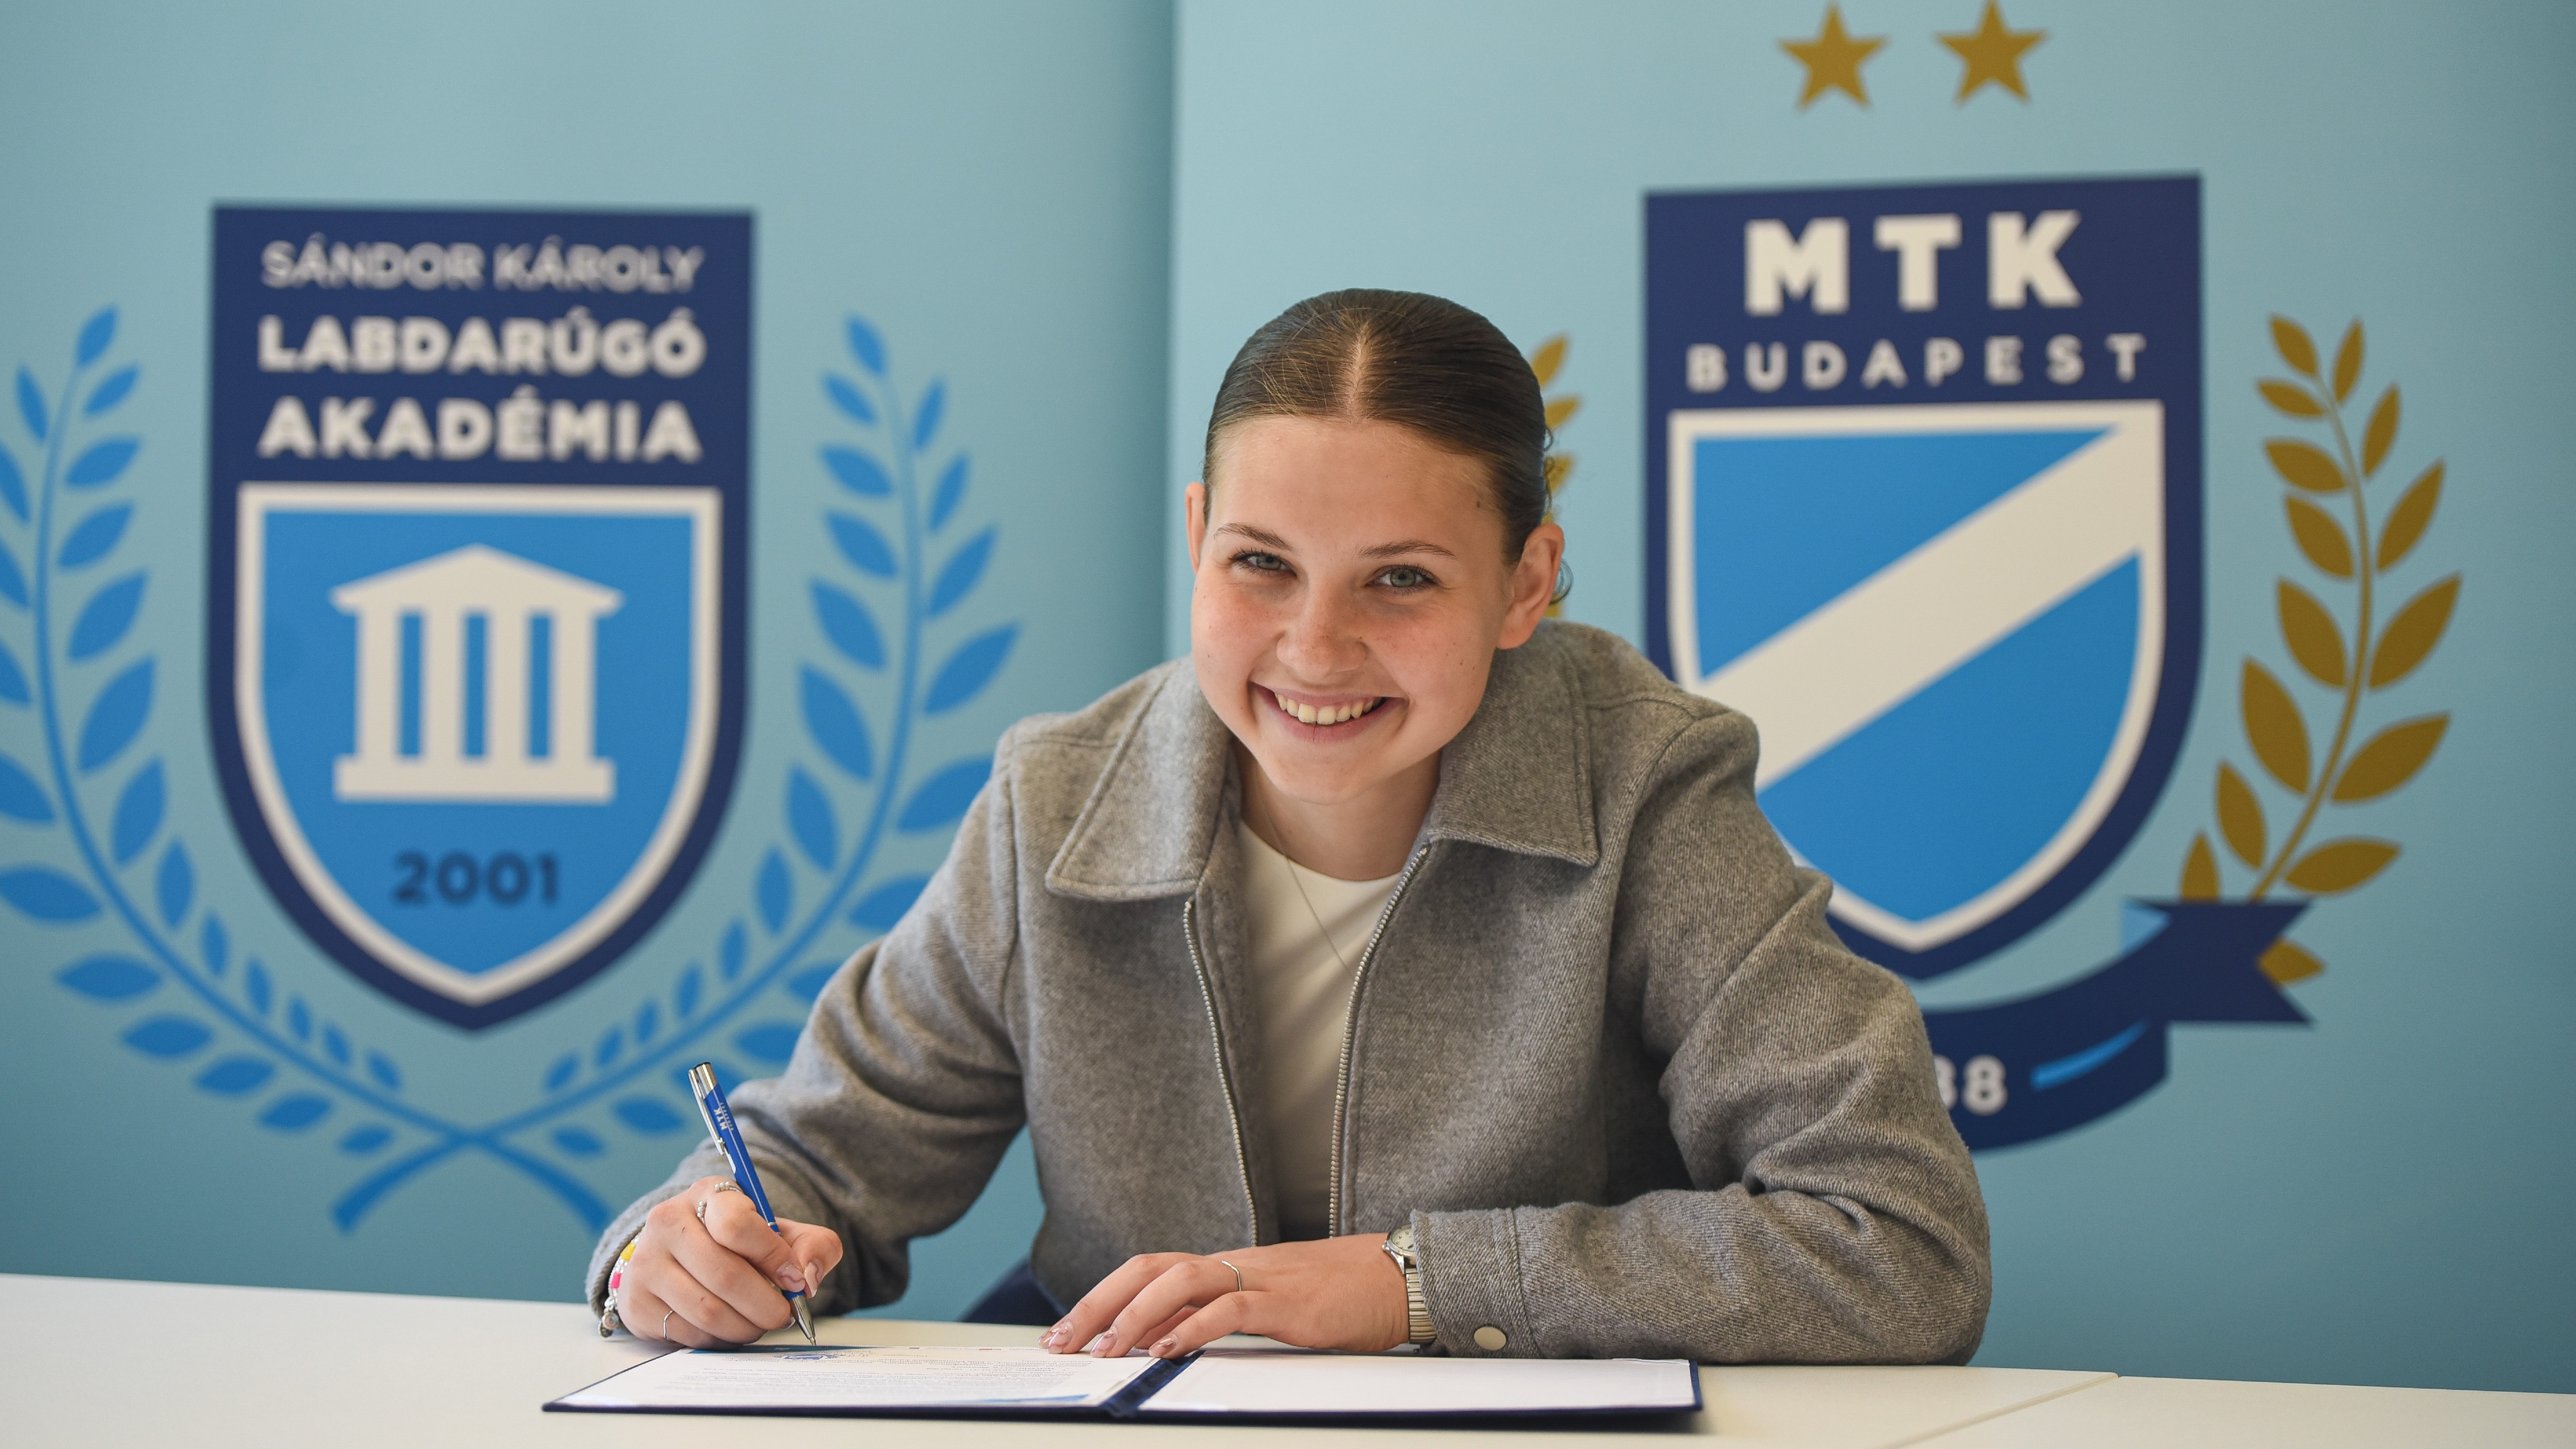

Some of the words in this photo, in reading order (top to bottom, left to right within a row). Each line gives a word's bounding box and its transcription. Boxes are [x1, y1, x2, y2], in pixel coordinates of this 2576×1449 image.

[261, 232, 484, 291] SÁNDOR
[494, 234, 704, 294] KÁROLY
[1745, 209, 2082, 316] MTK
[258, 305, 708, 377] LABDARÚGÓ
[1685, 333, 2146, 394] BUDAPEST
[257, 384, 703, 464] AKADÉMIA
[389, 850, 559, 908] 2001
[714, 1108, 728, 1130] MTK
